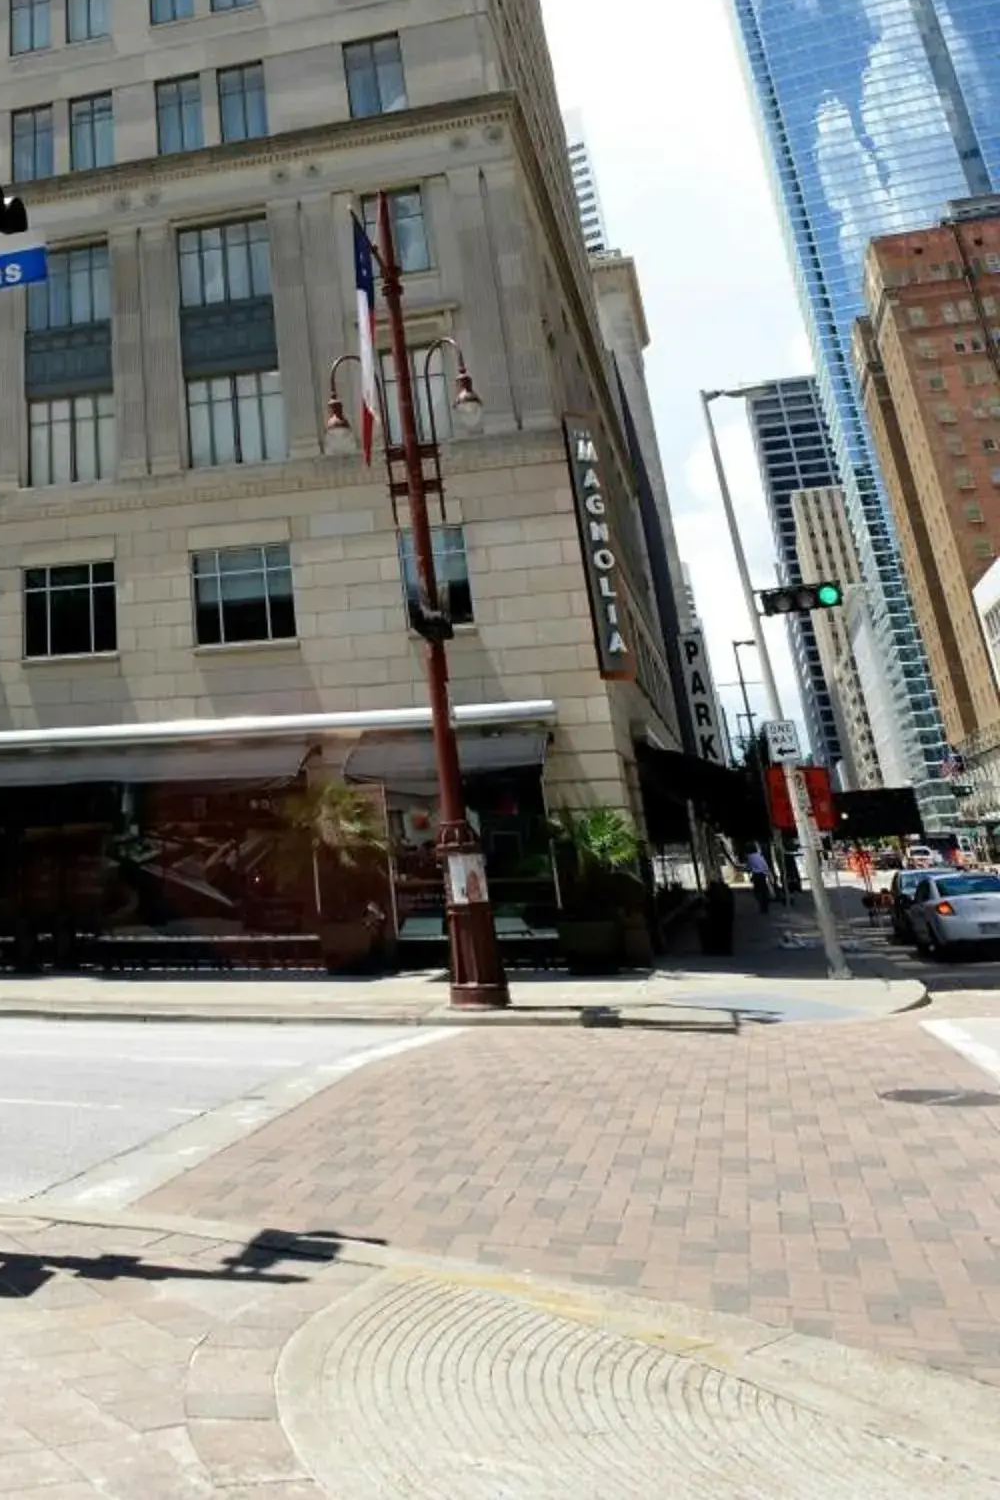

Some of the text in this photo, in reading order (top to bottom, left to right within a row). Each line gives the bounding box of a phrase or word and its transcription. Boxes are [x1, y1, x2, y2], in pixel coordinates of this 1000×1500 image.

[576, 438, 628, 655] MAGNOLIA
[684, 640, 719, 762] PARK
[769, 724, 792, 734] ONE
